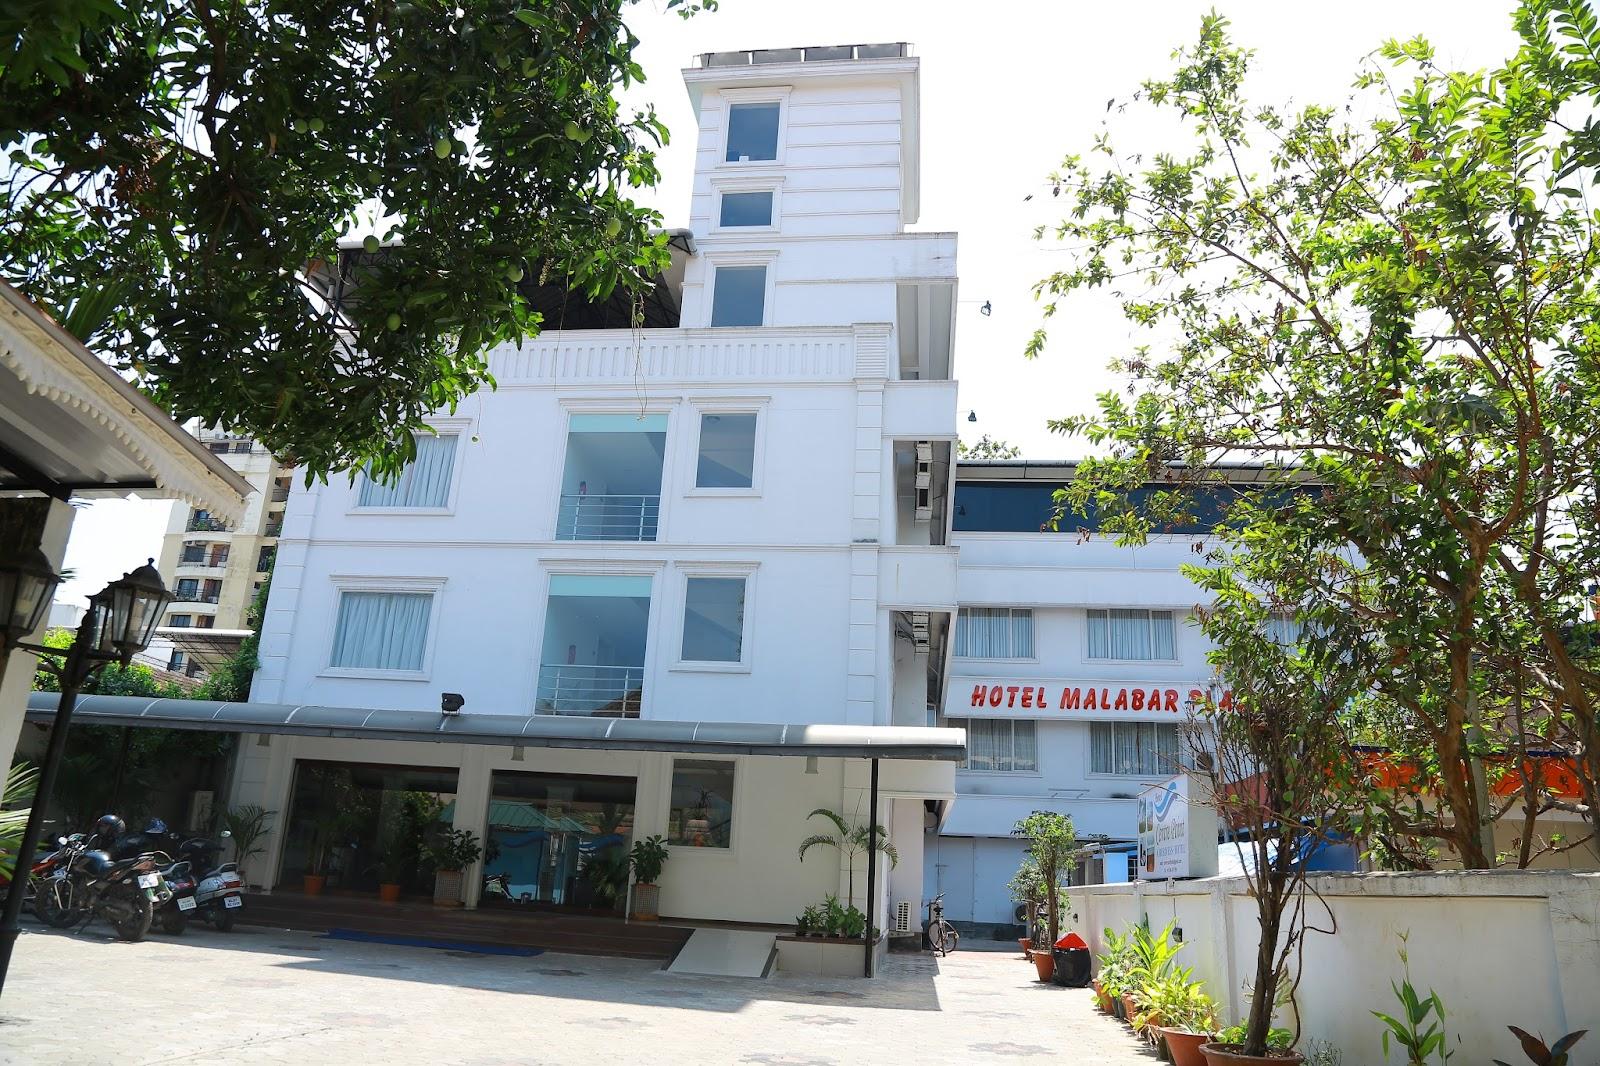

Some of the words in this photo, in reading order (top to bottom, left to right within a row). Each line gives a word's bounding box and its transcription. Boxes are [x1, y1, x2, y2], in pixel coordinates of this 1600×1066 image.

[971, 685, 1047, 708] HOTEL
[1059, 688, 1179, 713] MALABAR
[1189, 689, 1245, 714] PLA
